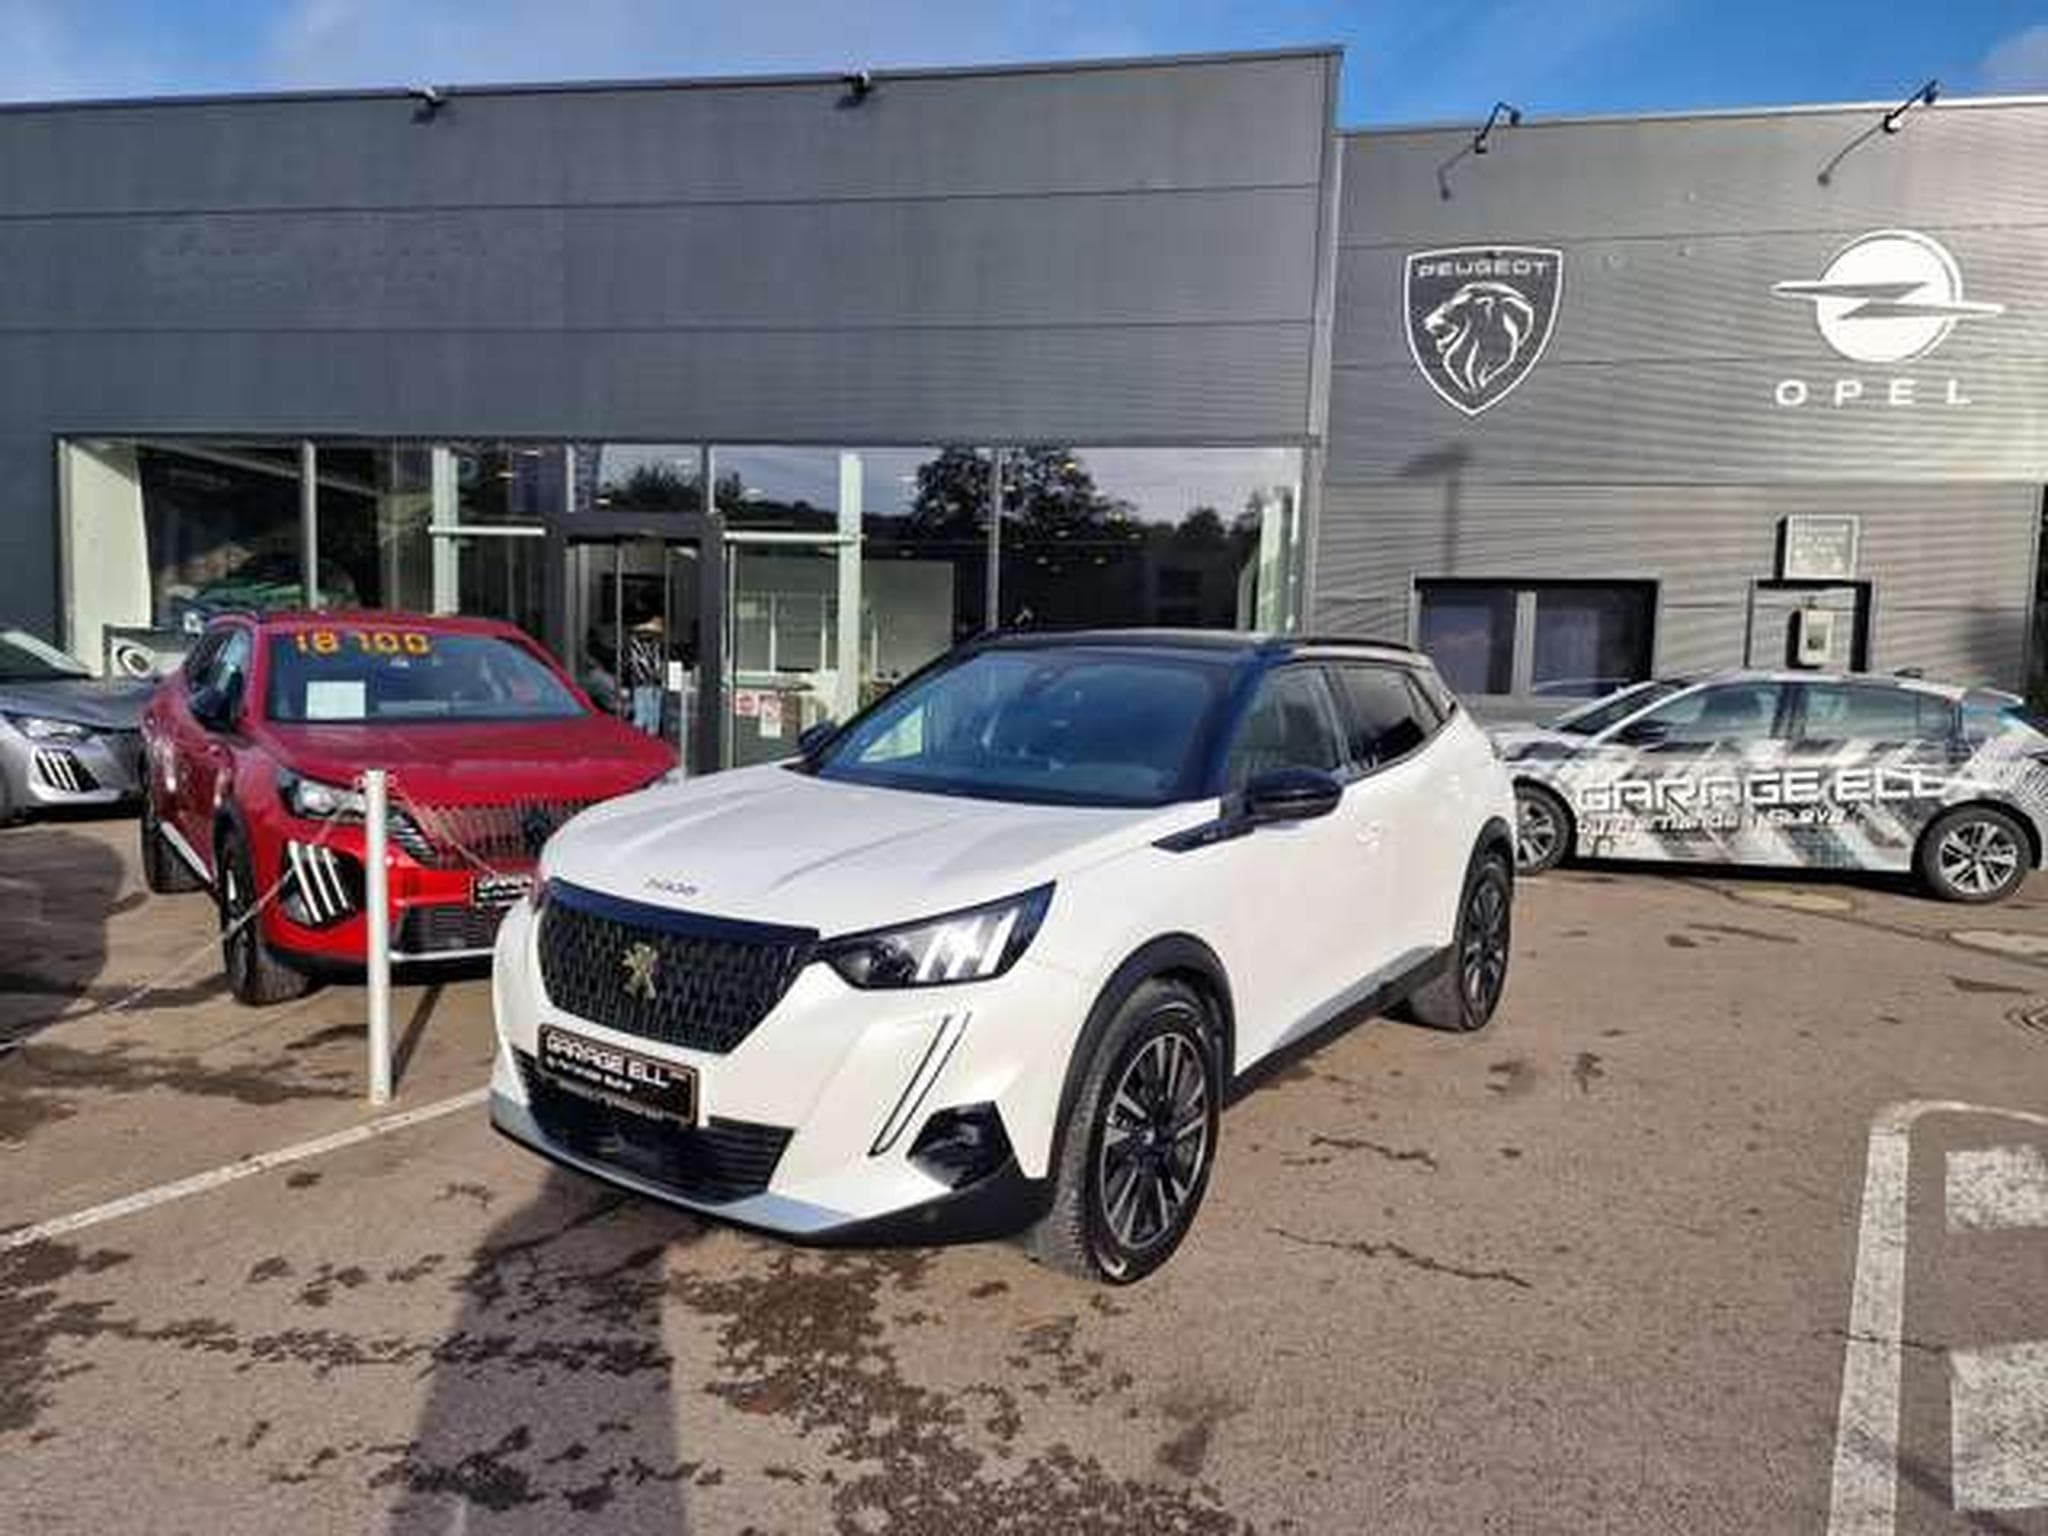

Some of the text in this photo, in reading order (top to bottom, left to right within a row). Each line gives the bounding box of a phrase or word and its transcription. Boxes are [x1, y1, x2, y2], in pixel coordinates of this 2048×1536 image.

[1418, 257, 1549, 277] PEUGEOT
[1776, 378, 1972, 406] OPEL
[1579, 765, 1947, 812] GARAGE ELL
[546, 1030, 625, 1076] GARAGE
[628, 1060, 671, 1089] ELL
